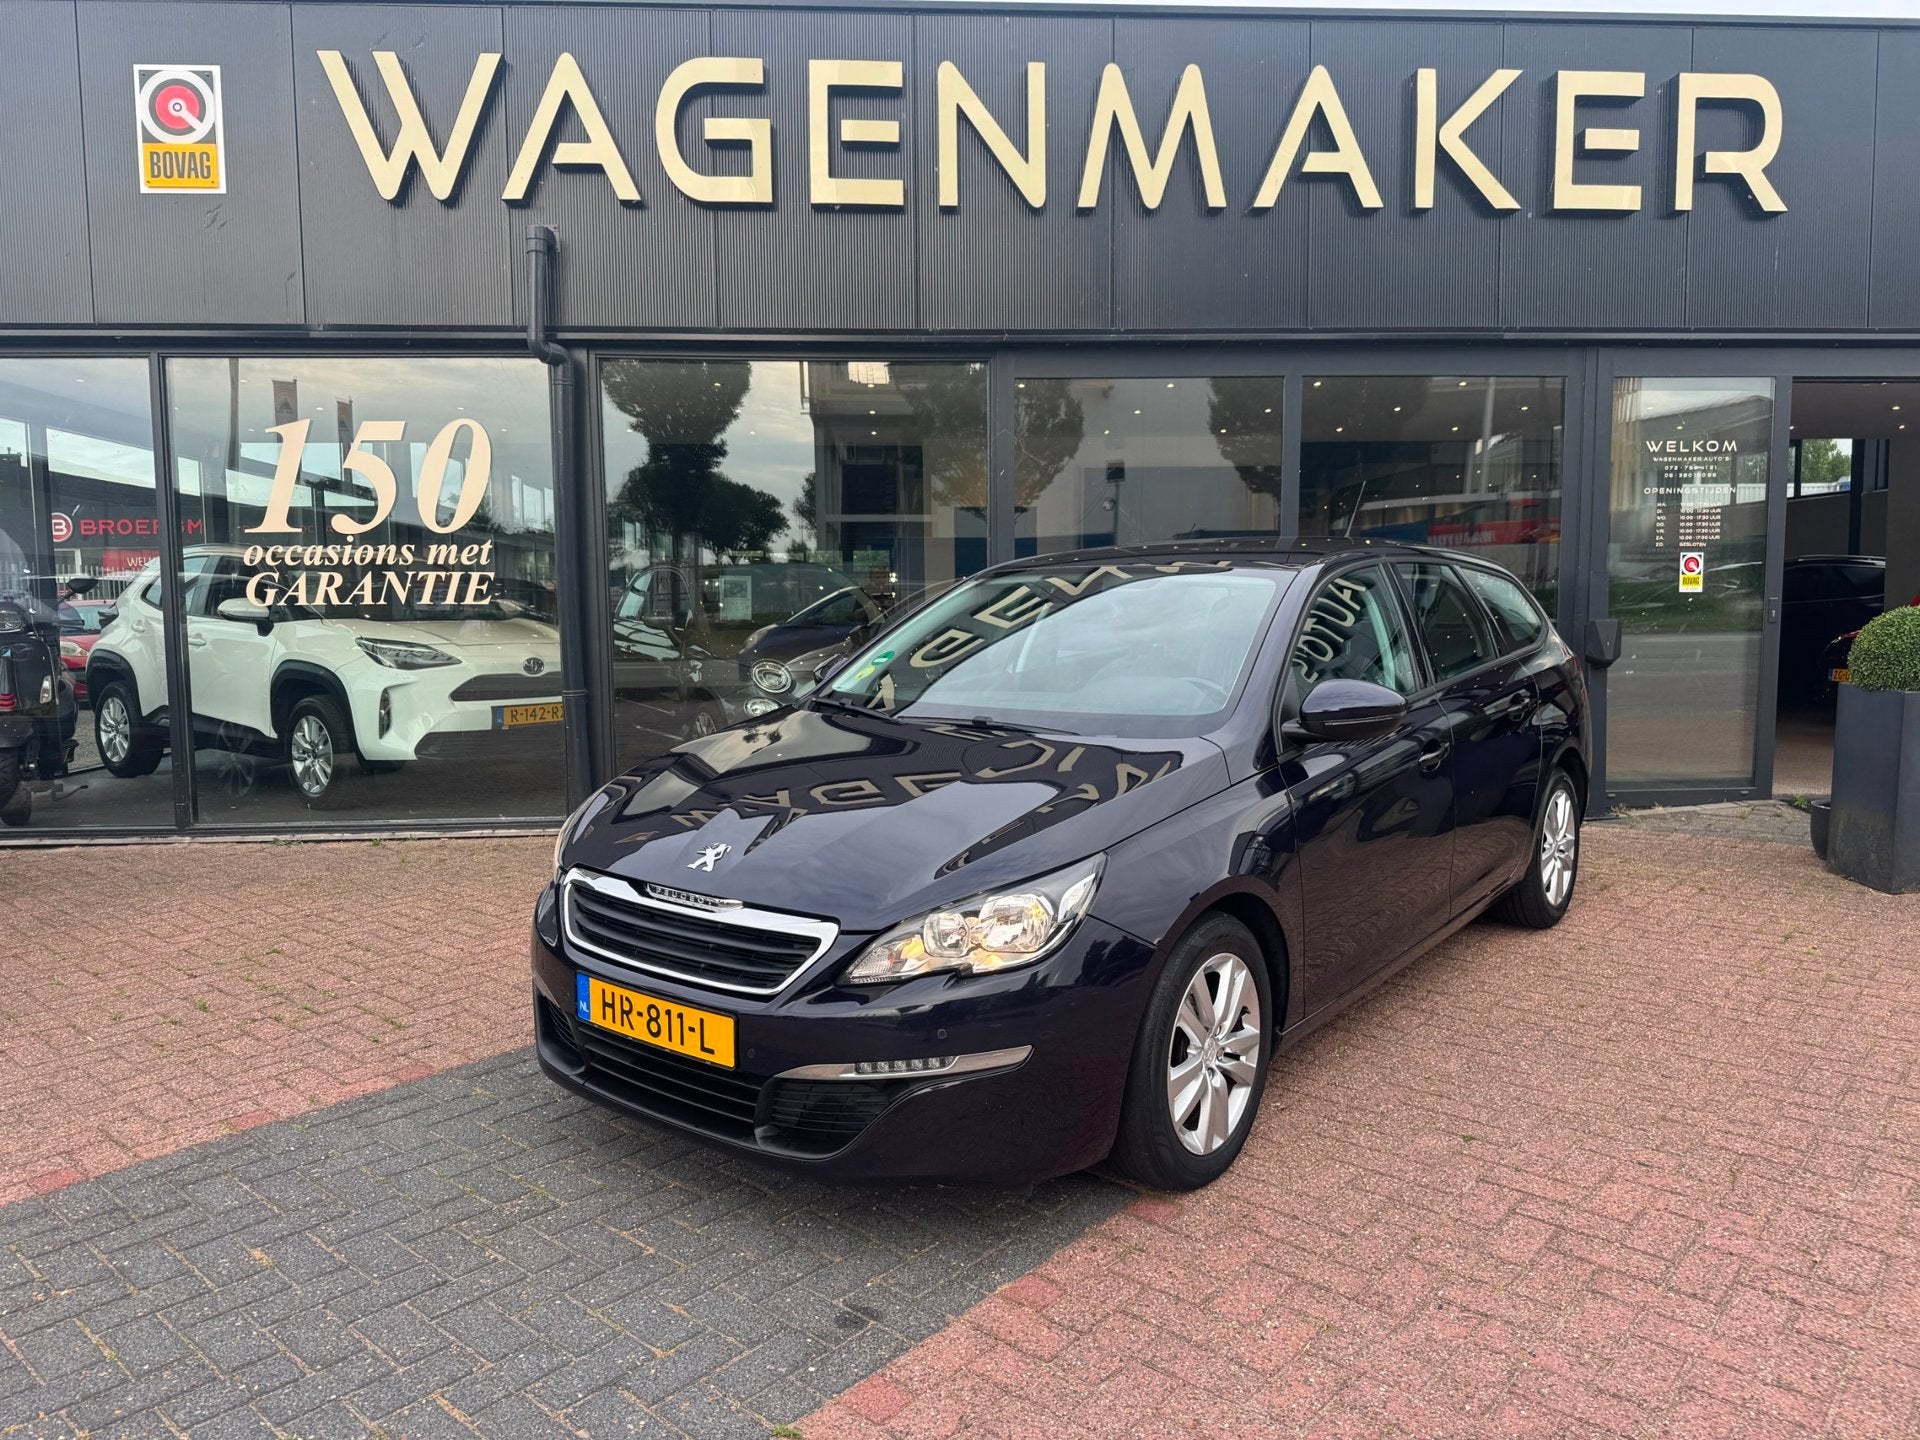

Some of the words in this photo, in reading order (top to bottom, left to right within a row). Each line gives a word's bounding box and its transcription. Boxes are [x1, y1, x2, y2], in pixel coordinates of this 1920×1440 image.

[317, 49, 1788, 214] WAGENMAKER
[149, 150, 212, 180] BOVAG
[1645, 440, 1738, 452] WELKOM
[244, 418, 493, 535] 150
[80, 518, 204, 535] BROEM
[243, 535, 416, 567] occasions
[427, 539, 493, 566] met
[245, 570, 496, 608] GARANTIE
[1682, 576, 1700, 586] BOVAG
[656, 887, 714, 906] PEUGEOT
[579, 1000, 590, 1013] NL
[601, 988, 715, 1055] HR-811-L
